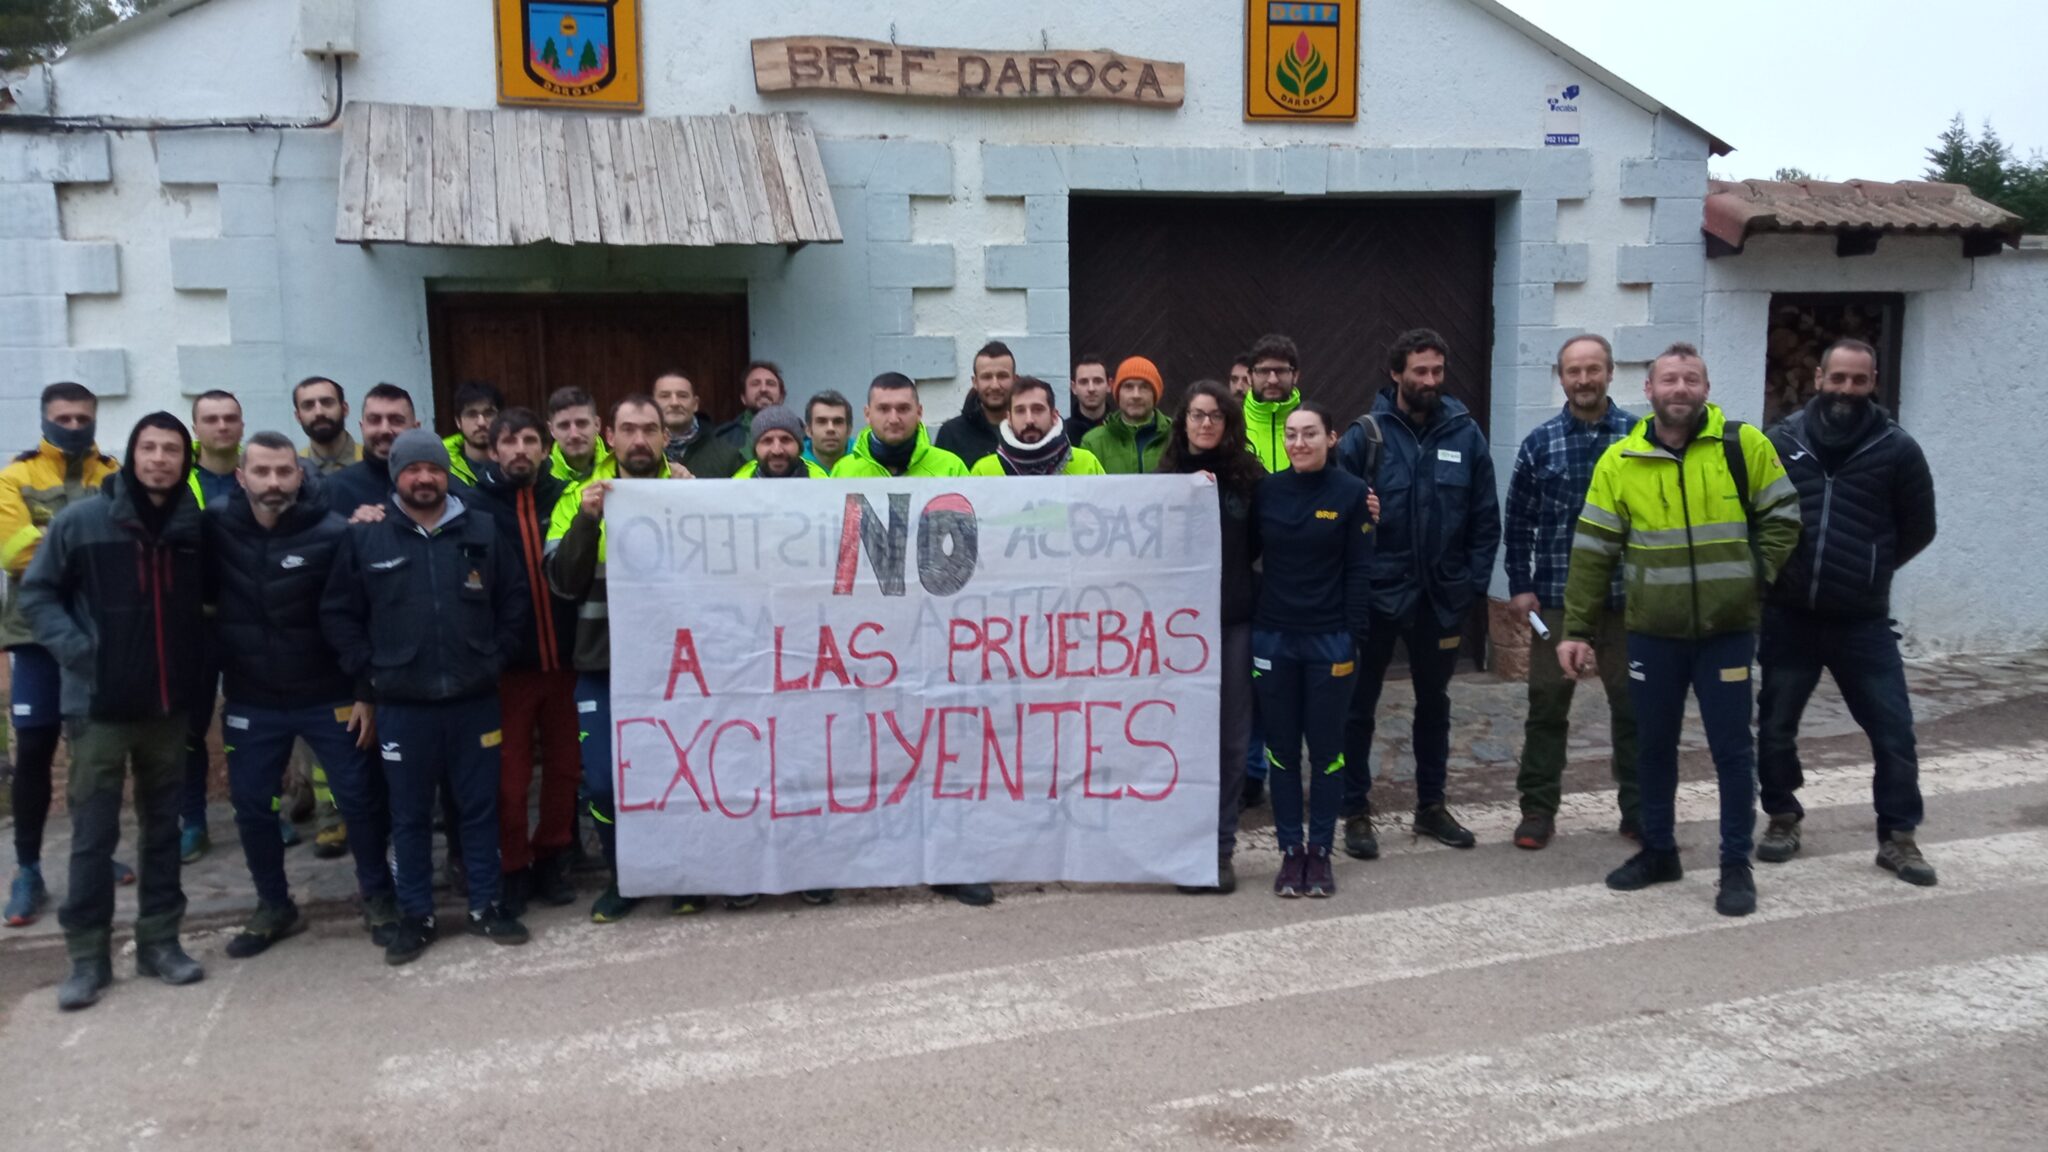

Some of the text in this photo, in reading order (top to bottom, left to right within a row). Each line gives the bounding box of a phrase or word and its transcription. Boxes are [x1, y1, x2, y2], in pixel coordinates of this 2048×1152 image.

[543, 81, 600, 96] DAROCA
[786, 45, 1165, 99] BRIF DAROCA
[1280, 93, 1325, 107] DAROCA
[833, 492, 979, 597] NO
[663, 628, 711, 700] A
[773, 621, 898, 693] LAS
[947, 608, 1209, 682] PRUEBAS
[616, 699, 1179, 820] EXCLUYENTES
